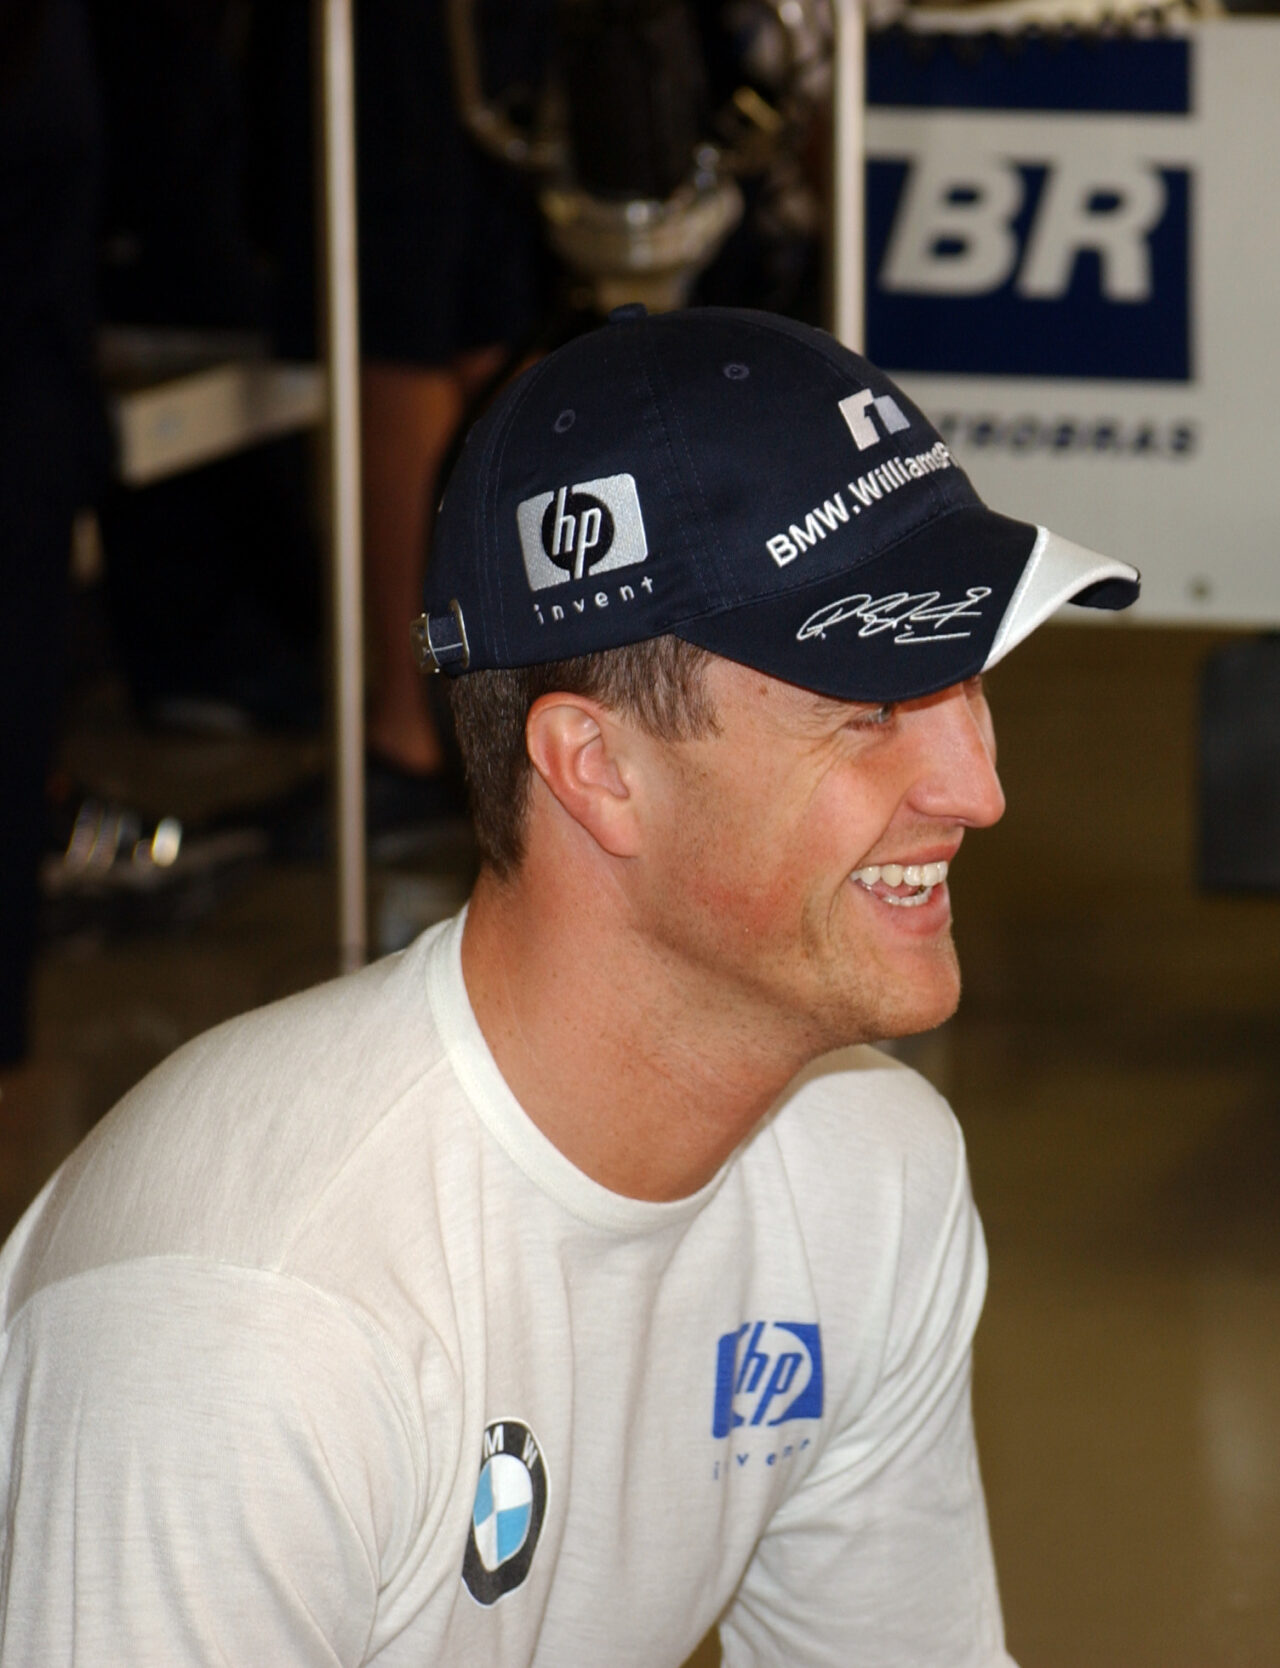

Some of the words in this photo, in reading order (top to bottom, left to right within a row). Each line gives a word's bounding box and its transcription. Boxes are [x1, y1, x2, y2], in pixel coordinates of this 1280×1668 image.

[880, 153, 1168, 302] BR
[552, 486, 602, 580] hp
[533, 576, 653, 625] invent
[734, 1320, 803, 1427] hp
